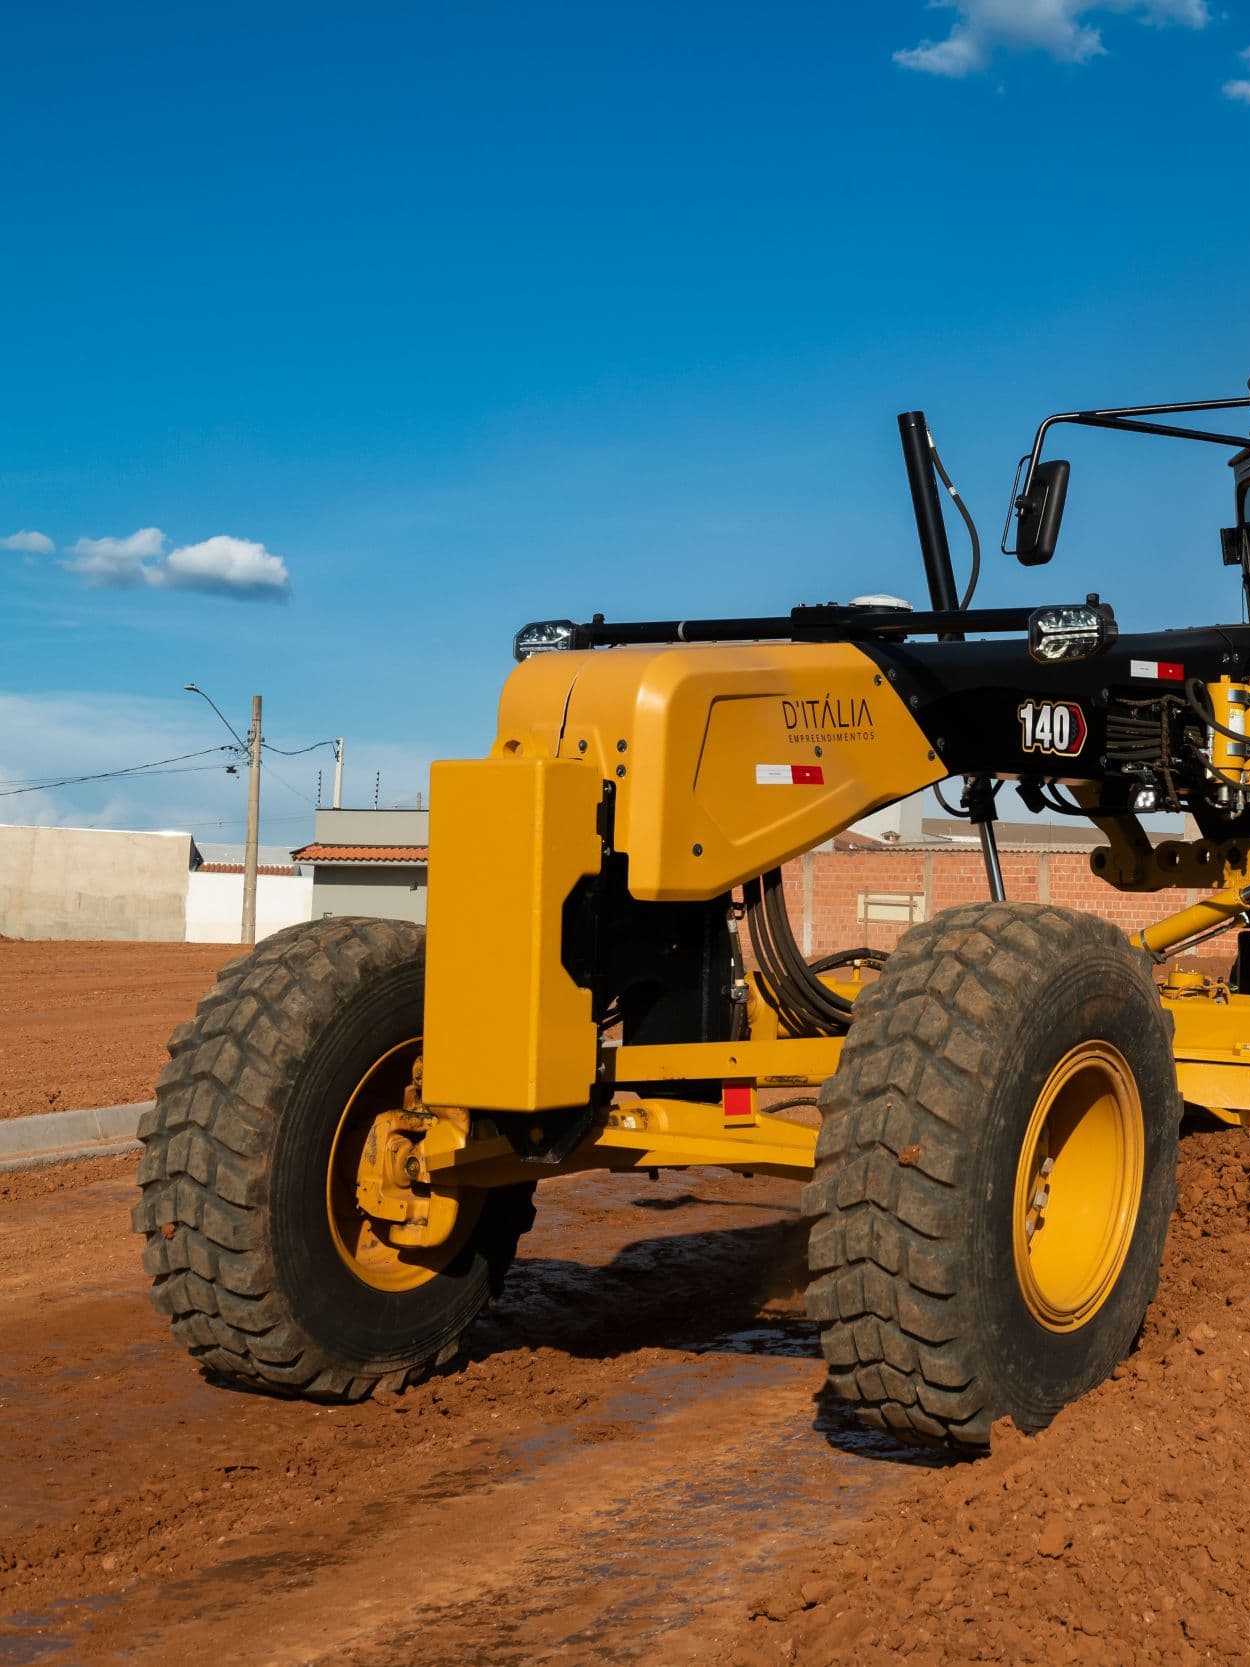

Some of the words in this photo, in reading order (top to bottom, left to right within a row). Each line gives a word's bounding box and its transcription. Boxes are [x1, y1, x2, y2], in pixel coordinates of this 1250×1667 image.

[782, 692, 873, 729] D'ITÁLIA
[1020, 703, 1070, 751] 140
[788, 731, 875, 743] EMPREENDIMENTOS
